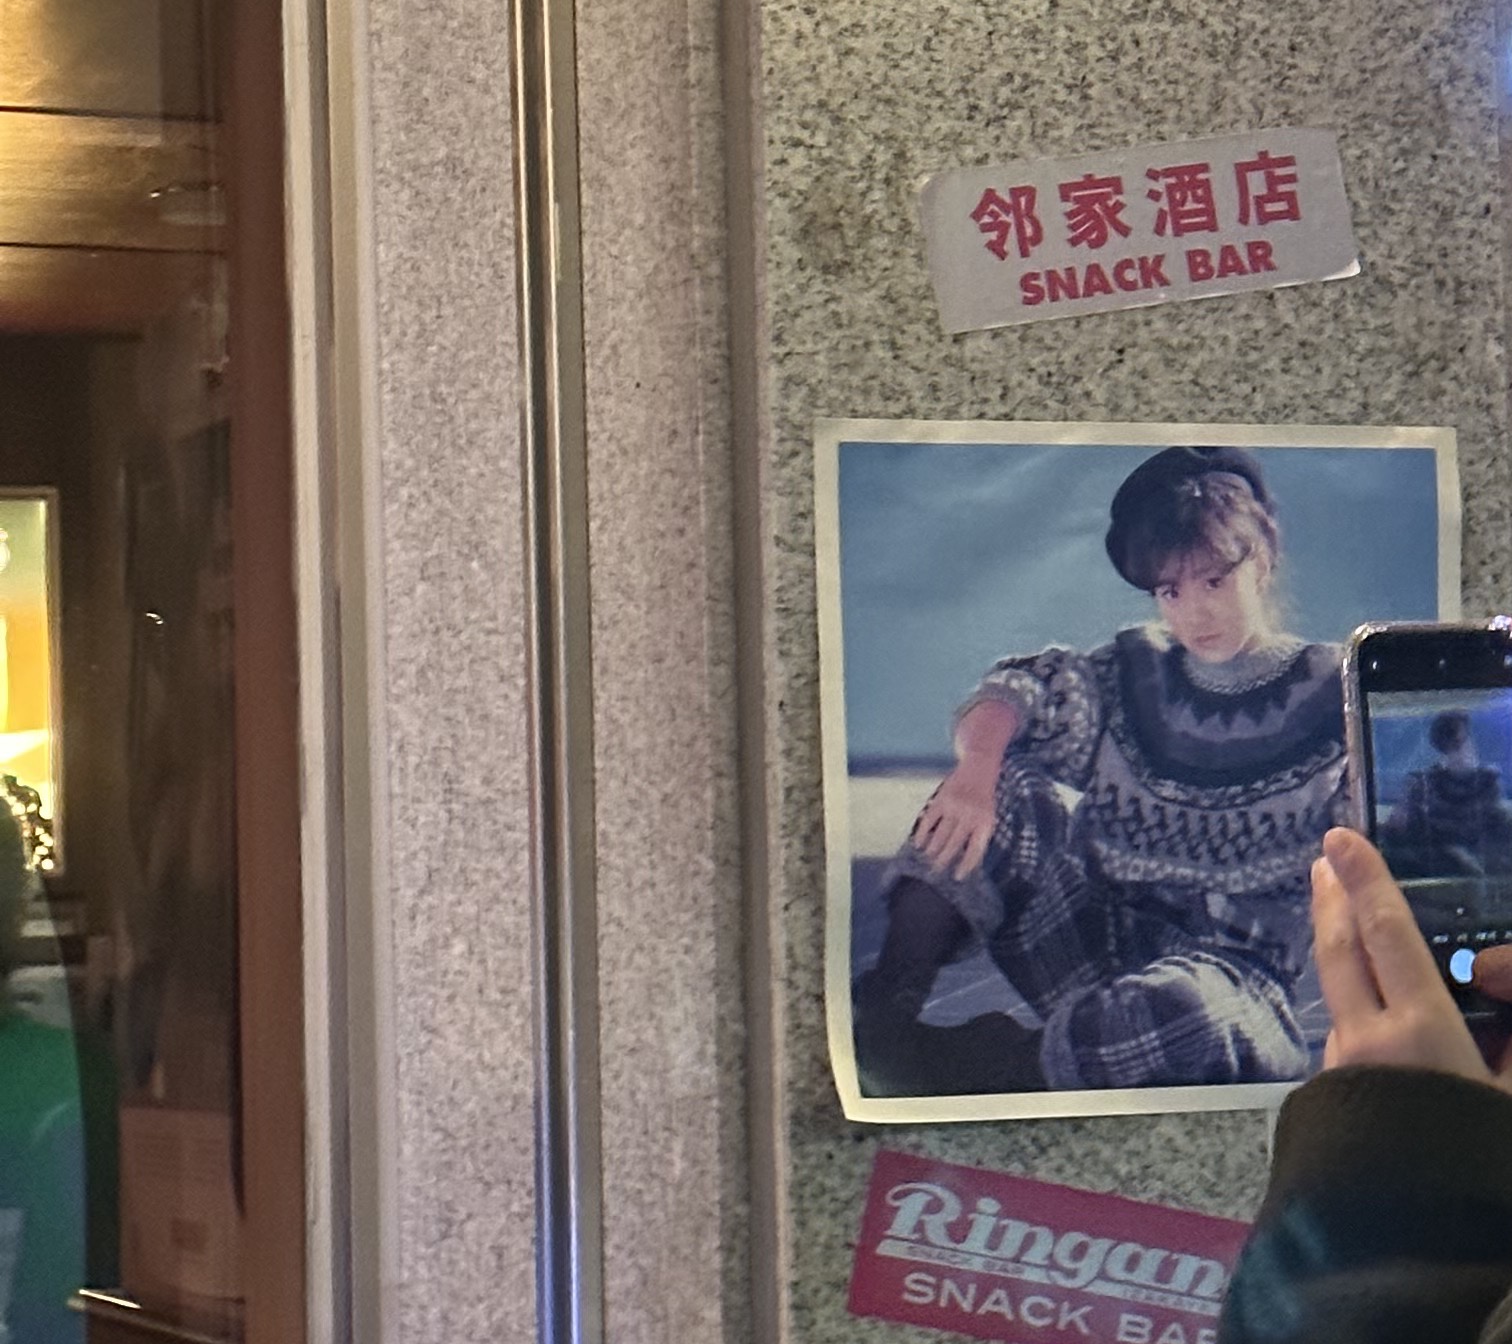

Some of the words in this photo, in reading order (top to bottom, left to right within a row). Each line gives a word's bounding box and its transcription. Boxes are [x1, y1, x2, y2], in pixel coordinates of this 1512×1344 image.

[969, 151, 1302, 262] 邻家酒店
[1020, 253, 1169, 308] SNACK
[1186, 239, 1277, 286] BAR
[902, 1272, 1094, 1335] SNACK
